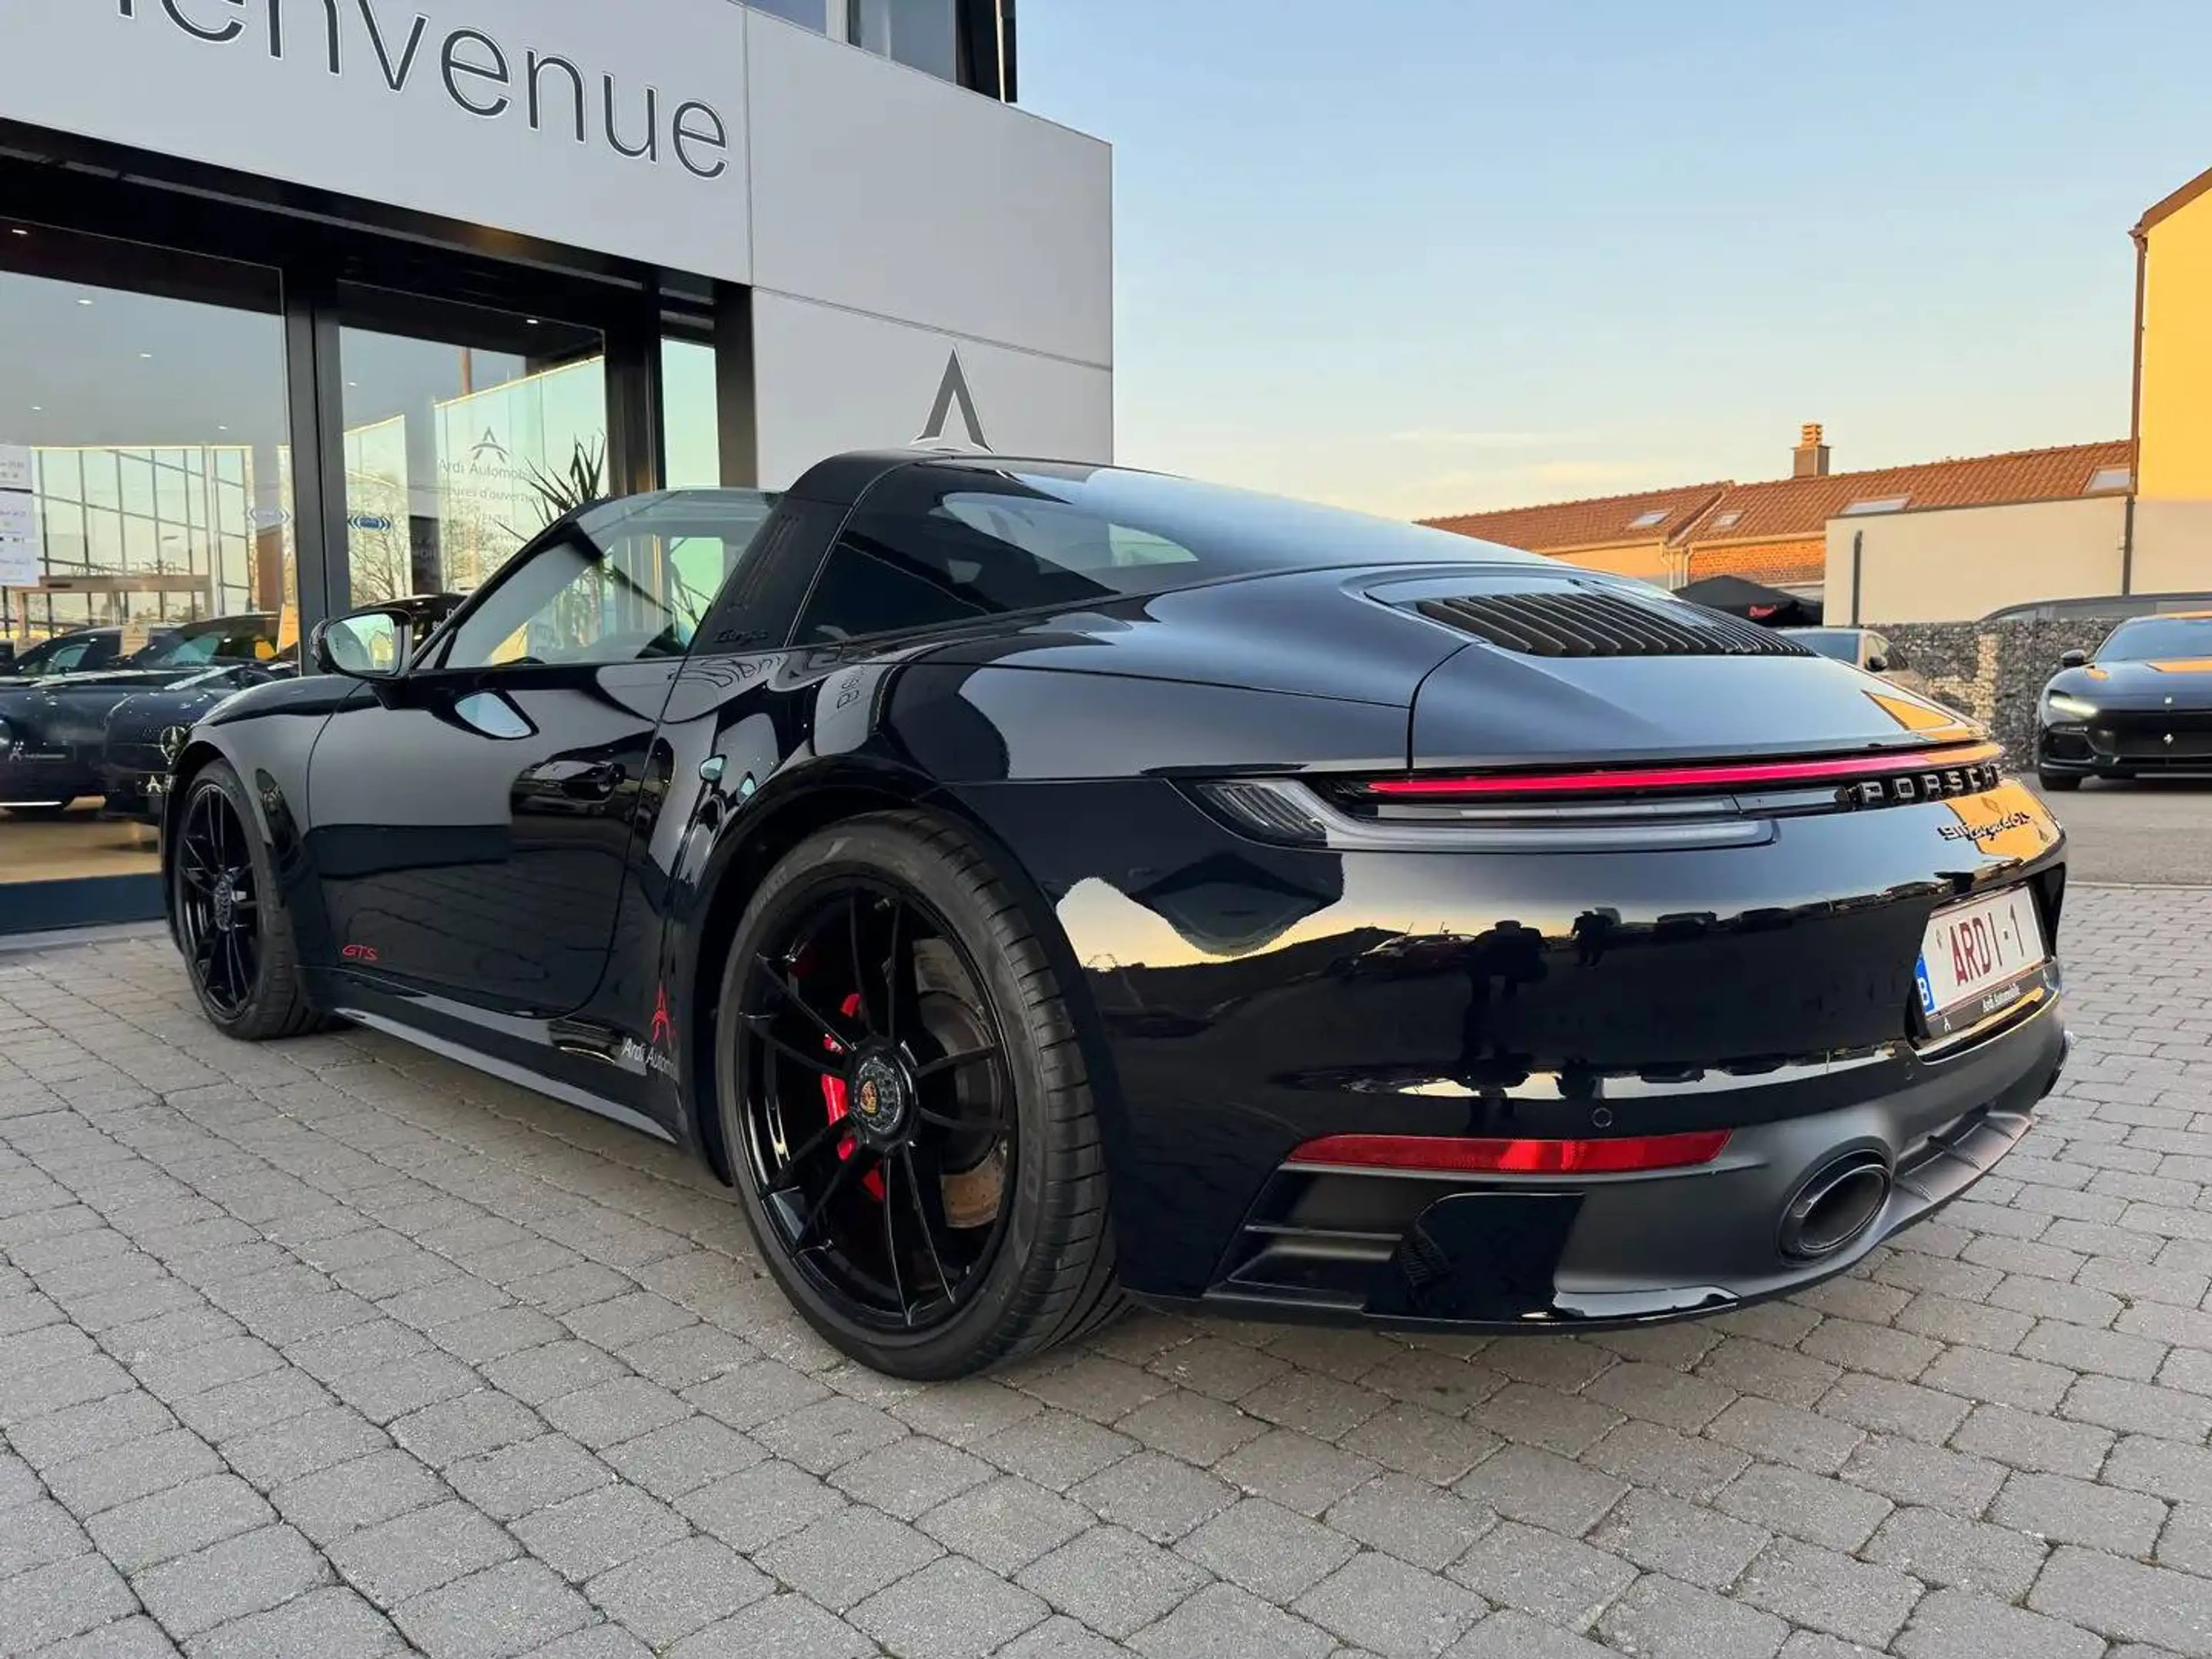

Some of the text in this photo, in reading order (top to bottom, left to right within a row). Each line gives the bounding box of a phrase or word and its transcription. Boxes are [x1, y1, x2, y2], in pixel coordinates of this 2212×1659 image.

[118, 0, 728, 179] envenue
[343, 944, 377, 961] GTS
[1917, 978, 1930, 1007] B
